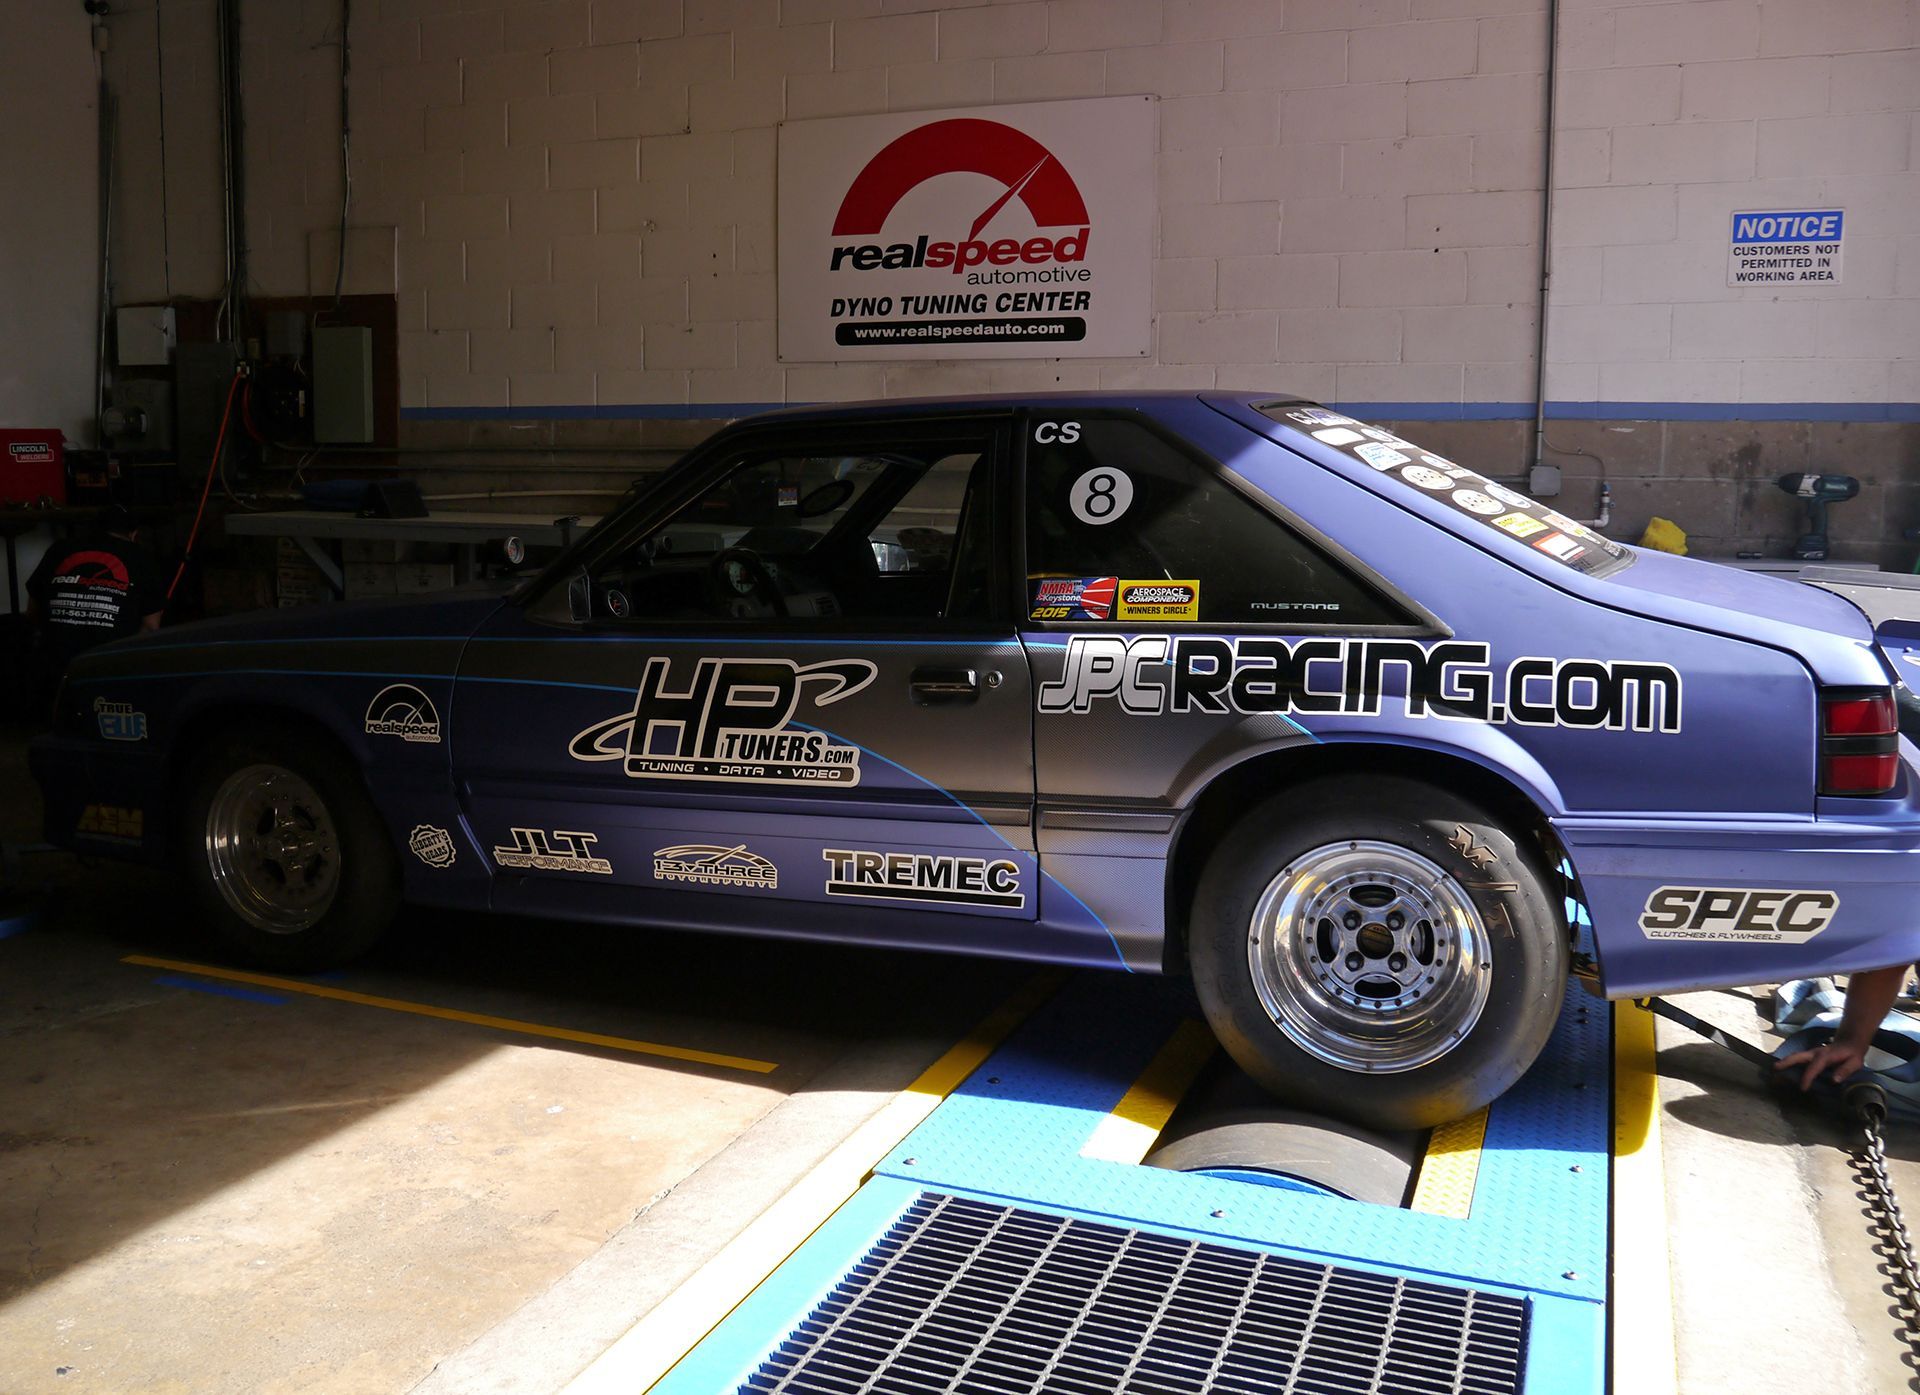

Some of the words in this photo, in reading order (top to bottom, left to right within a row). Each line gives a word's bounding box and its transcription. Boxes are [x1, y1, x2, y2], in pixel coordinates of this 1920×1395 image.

[1737, 216, 1839, 239] NOTICE
[830, 228, 1090, 274] realspeed
[1733, 245, 1810, 256] CUSTOMERS
[1815, 244, 1840, 254] NOT
[1741, 258, 1813, 269] PERMITTED
[1818, 258, 1830, 267] IN
[967, 266, 1091, 286] automotive
[1736, 271, 1795, 282] WORKING
[1800, 271, 1834, 281] AREA
[831, 296, 893, 317] DYNO
[900, 293, 987, 315] TUNING
[995, 291, 1091, 312] CENTER
[854, 322, 1065, 339] www.realspeedauto.com
[1035, 421, 1082, 444] CS
[12, 445, 46, 453] LINCOLN
[1085, 474, 1116, 517] 8
[1040, 582, 1074, 595] NMRA
[1132, 588, 1184, 596] AEROSPACE
[1043, 594, 1082, 603] Keystone
[1127, 595, 1190, 603] COMPONENTS
[1031, 607, 1071, 618] 2015
[1127, 606, 1160, 614] WINNERS
[1163, 606, 1188, 614] CIRCLE
[1251, 602, 1340, 611] MUSTANG
[100, 703, 132, 713] TRUE
[627, 657, 800, 758] HP
[367, 722, 438, 735] realspeed
[639, 761, 695, 774] TUNING
[718, 764, 765, 776] DATA
[791, 768, 841, 779] VIDEO
[495, 828, 598, 858] JLT
[495, 853, 612, 874] PERFORMANCE
[824, 850, 1019, 893] TREMEC
[655, 872, 776, 888] MOTORSPORTS
[1643, 889, 1835, 932] SPEC
[1650, 930, 1707, 939] CLUTCHES
[1718, 932, 1783, 941] FLYWHEELS
